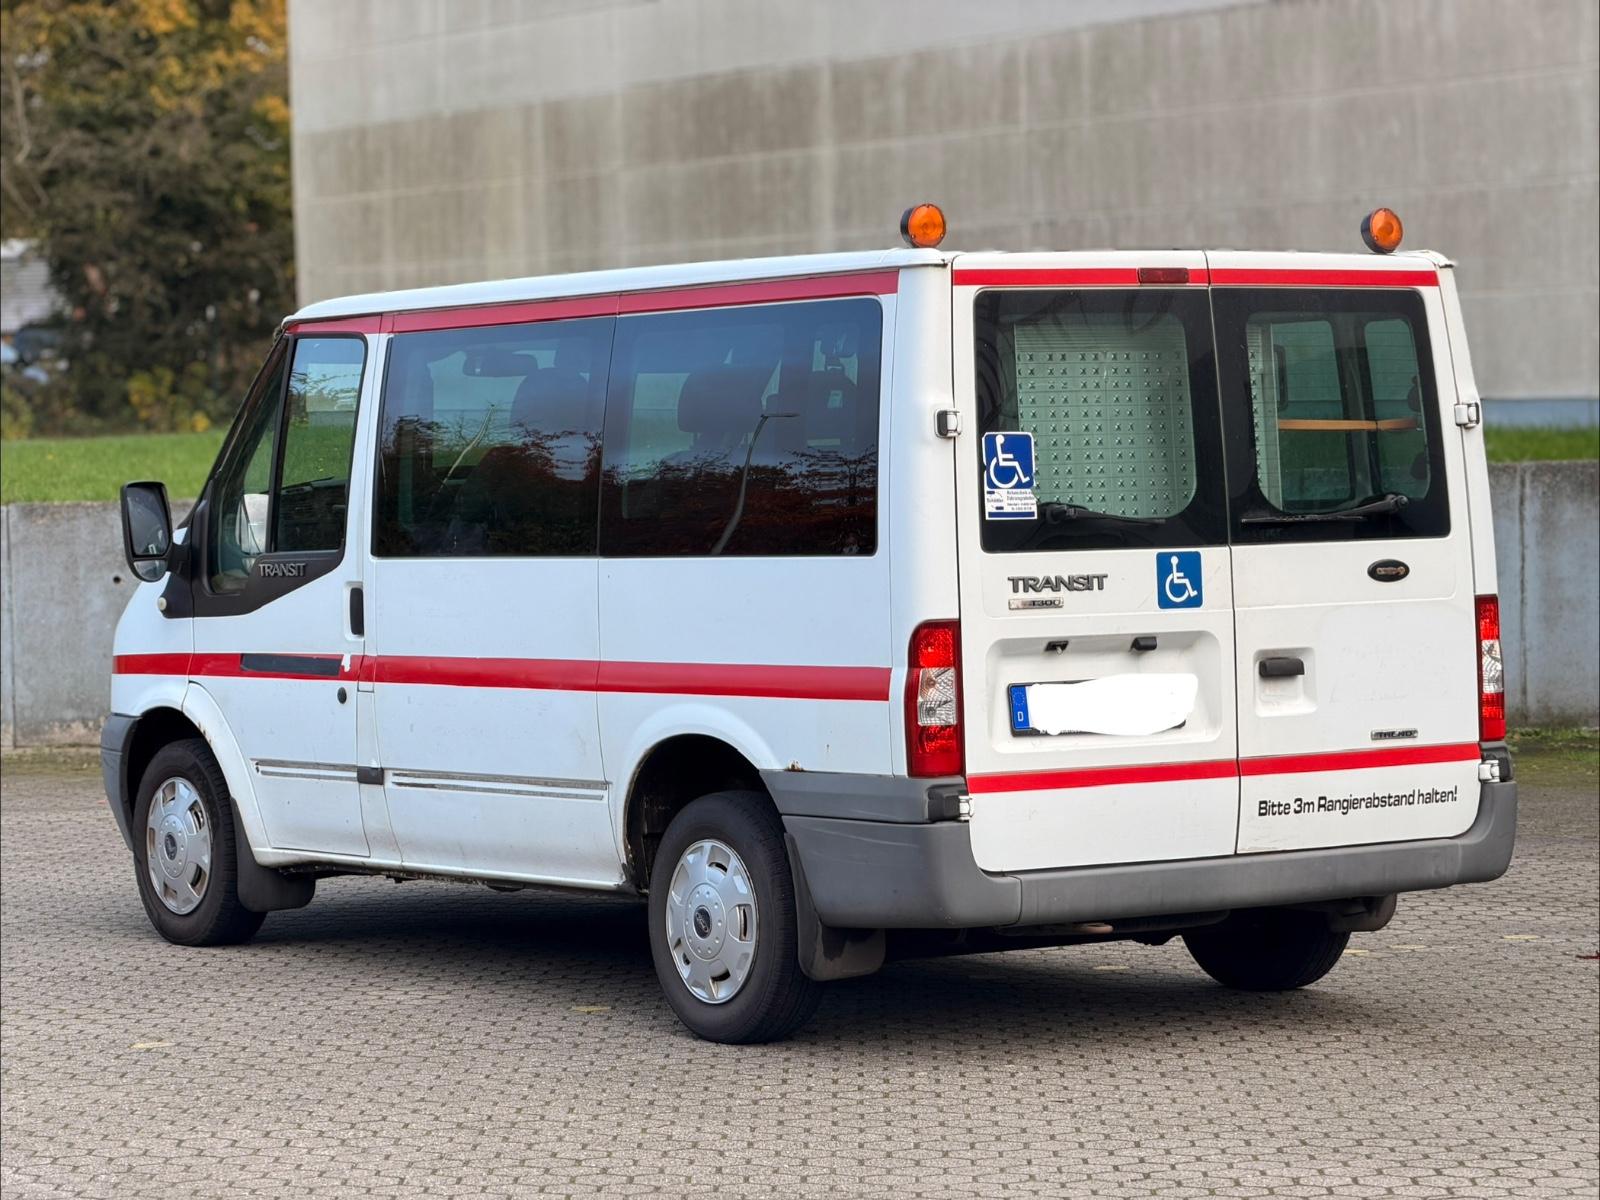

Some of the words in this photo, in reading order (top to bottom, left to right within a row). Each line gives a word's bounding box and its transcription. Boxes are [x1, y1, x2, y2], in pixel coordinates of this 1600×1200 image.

[258, 562, 306, 577] TRANSIT
[1007, 573, 1108, 593] TRANSIT
[1017, 711, 1024, 721] D
[1258, 799, 1291, 816] Bitte
[1293, 797, 1315, 814] 3m
[1317, 788, 1415, 815] Rangierabstand
[1417, 785, 1457, 805] halten!
